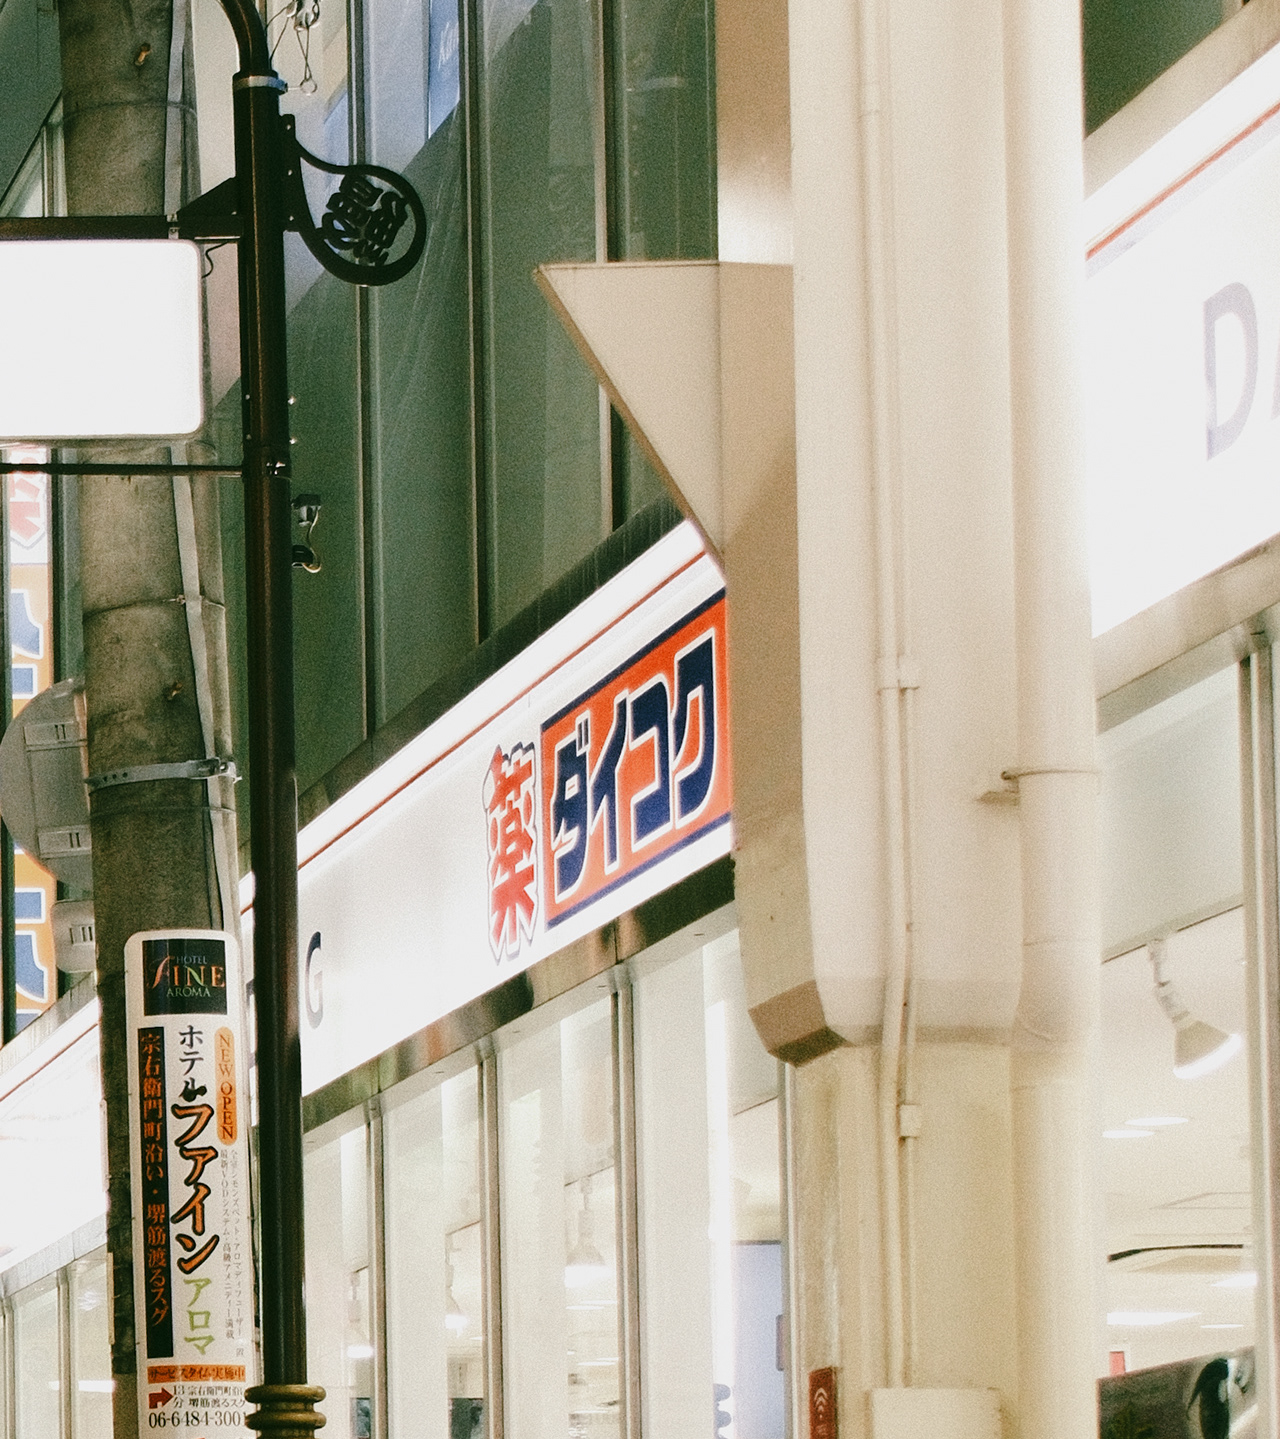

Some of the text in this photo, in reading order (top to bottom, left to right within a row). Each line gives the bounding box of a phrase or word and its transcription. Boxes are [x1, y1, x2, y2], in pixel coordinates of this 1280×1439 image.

[488, 626, 717, 950] 薬 ダイコク
[219, 1081, 234, 1140] OPEN
